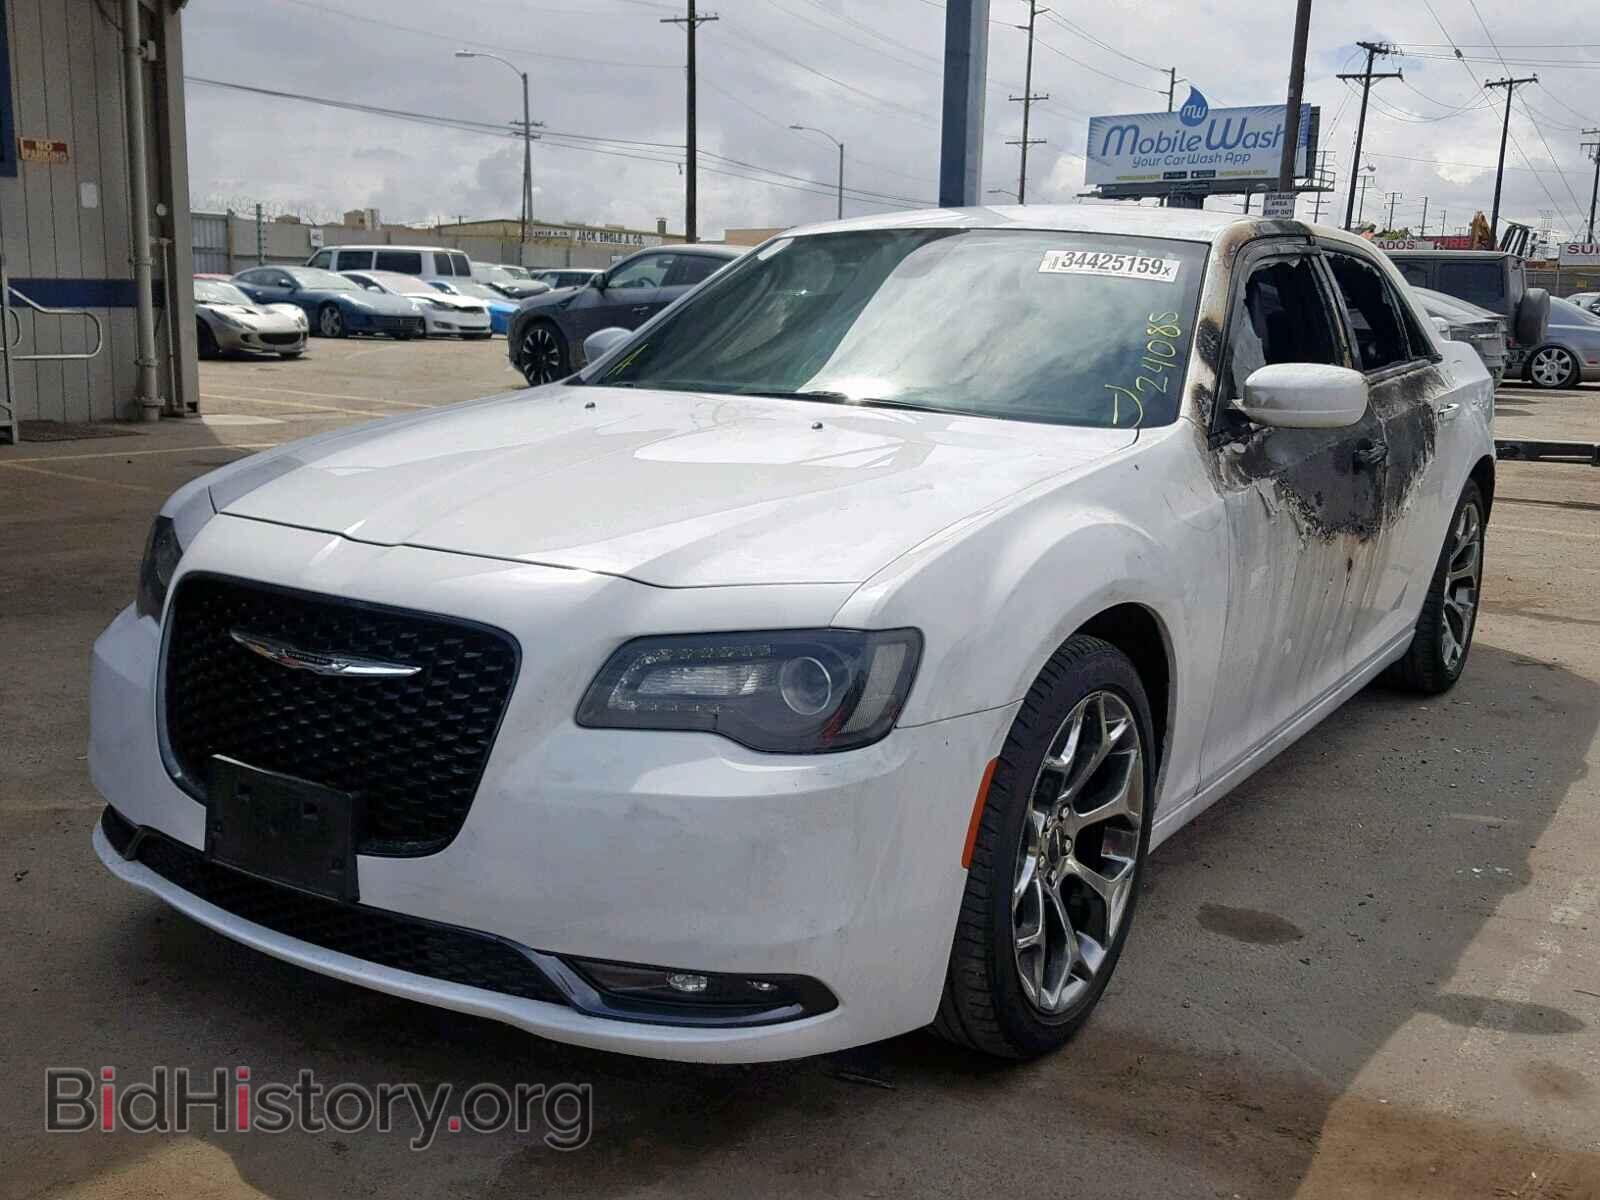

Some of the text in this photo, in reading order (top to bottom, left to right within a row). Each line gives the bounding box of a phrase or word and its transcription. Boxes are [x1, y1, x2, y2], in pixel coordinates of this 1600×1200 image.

[36, 141, 53, 151] NO
[1223, 151, 1252, 166] App
[1263, 208, 1292, 216] KEEP OUT
[576, 230, 596, 242] JACK
